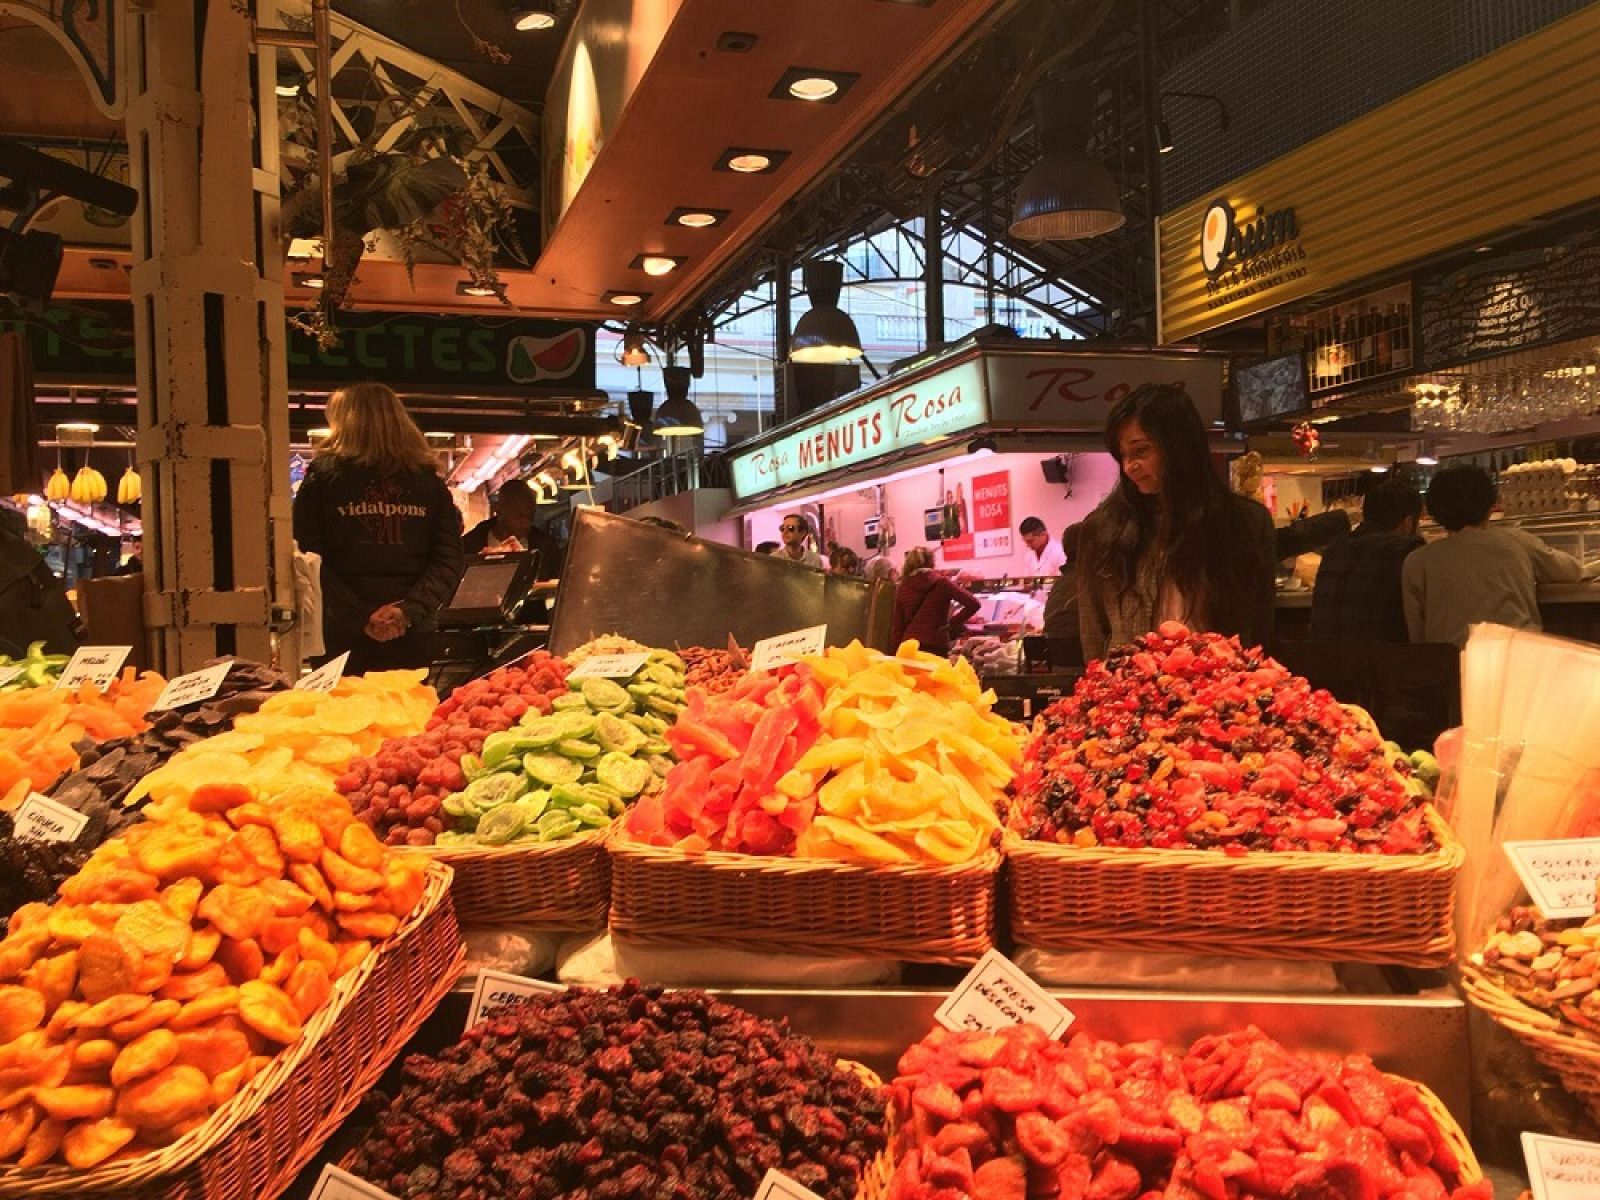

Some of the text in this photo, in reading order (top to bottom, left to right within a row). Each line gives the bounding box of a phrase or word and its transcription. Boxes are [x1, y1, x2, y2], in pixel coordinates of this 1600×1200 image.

[751, 450, 789, 477] Rosa
[799, 411, 883, 470] MENUTS
[890, 384, 962, 438] Rosa
[337, 501, 427, 518] vidalpons
[980, 503, 1003, 518] ROSA
